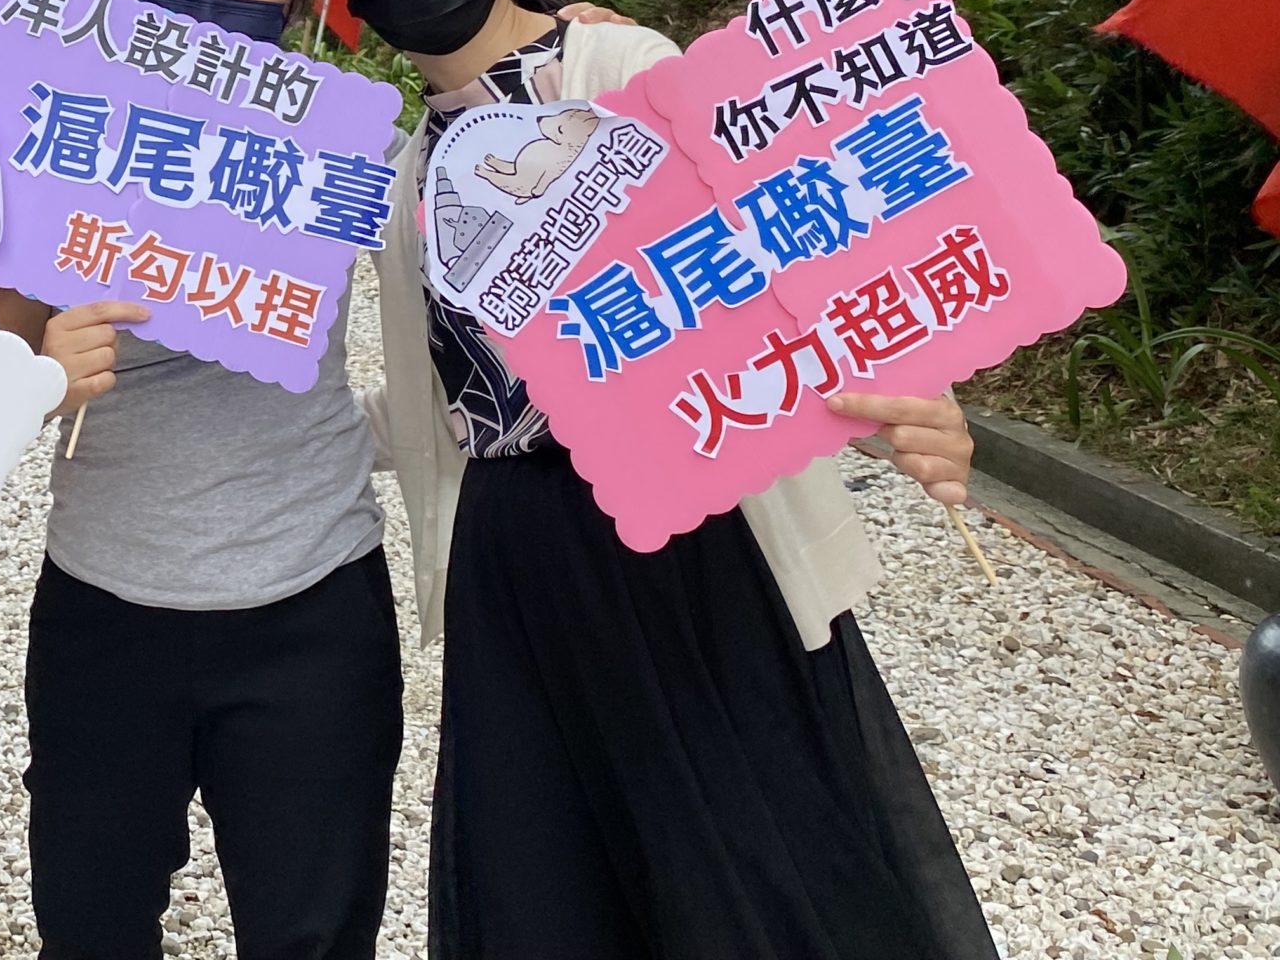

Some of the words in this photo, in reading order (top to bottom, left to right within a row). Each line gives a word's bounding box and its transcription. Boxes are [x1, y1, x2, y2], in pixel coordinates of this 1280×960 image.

[14, 83, 396, 248] 滬尾礮臺
[712, 4, 971, 159] 你不知道
[58, 214, 321, 347] 斯勾以捏
[479, 123, 663, 330] 躺著也中槍
[556, 97, 968, 379] 滬尾礮臺
[676, 226, 1008, 456] 火力超威
